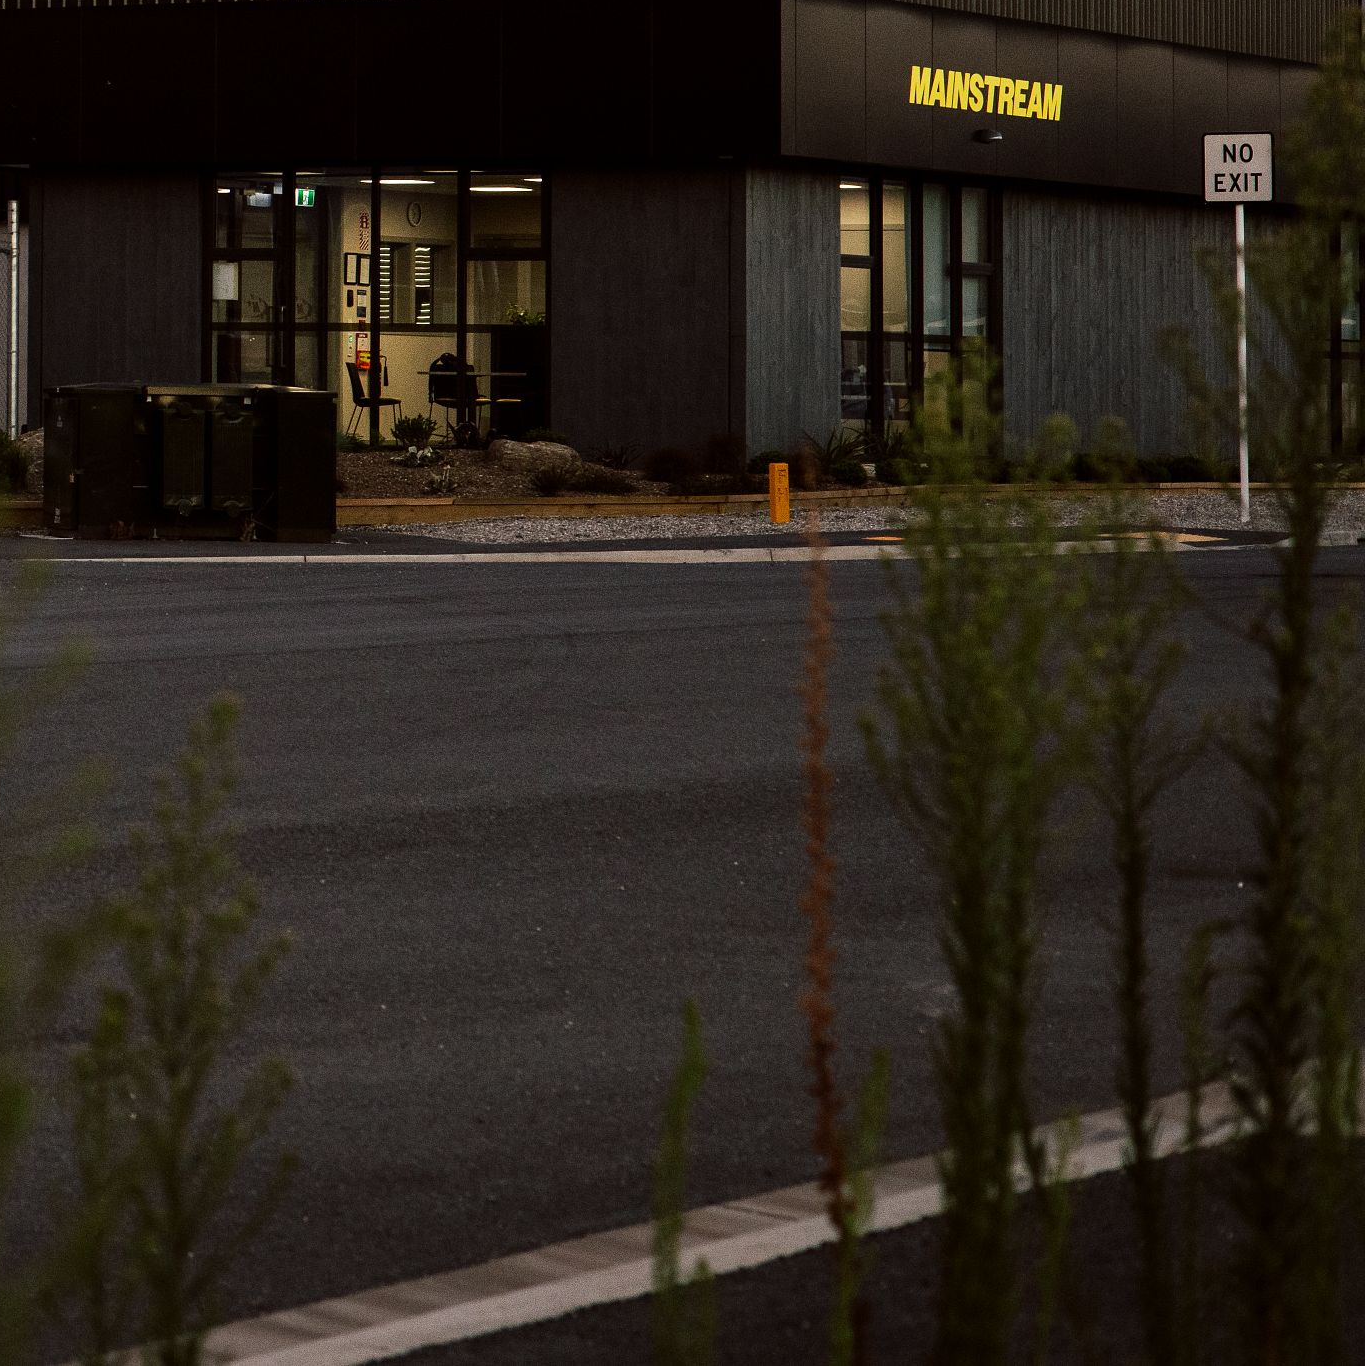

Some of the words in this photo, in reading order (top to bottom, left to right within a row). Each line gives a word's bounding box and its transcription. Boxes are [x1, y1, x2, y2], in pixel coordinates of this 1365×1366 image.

[909, 65, 1063, 121] MAINSTREAM
[1223, 143, 1253, 163] NO
[1214, 173, 1262, 192] EXIT
